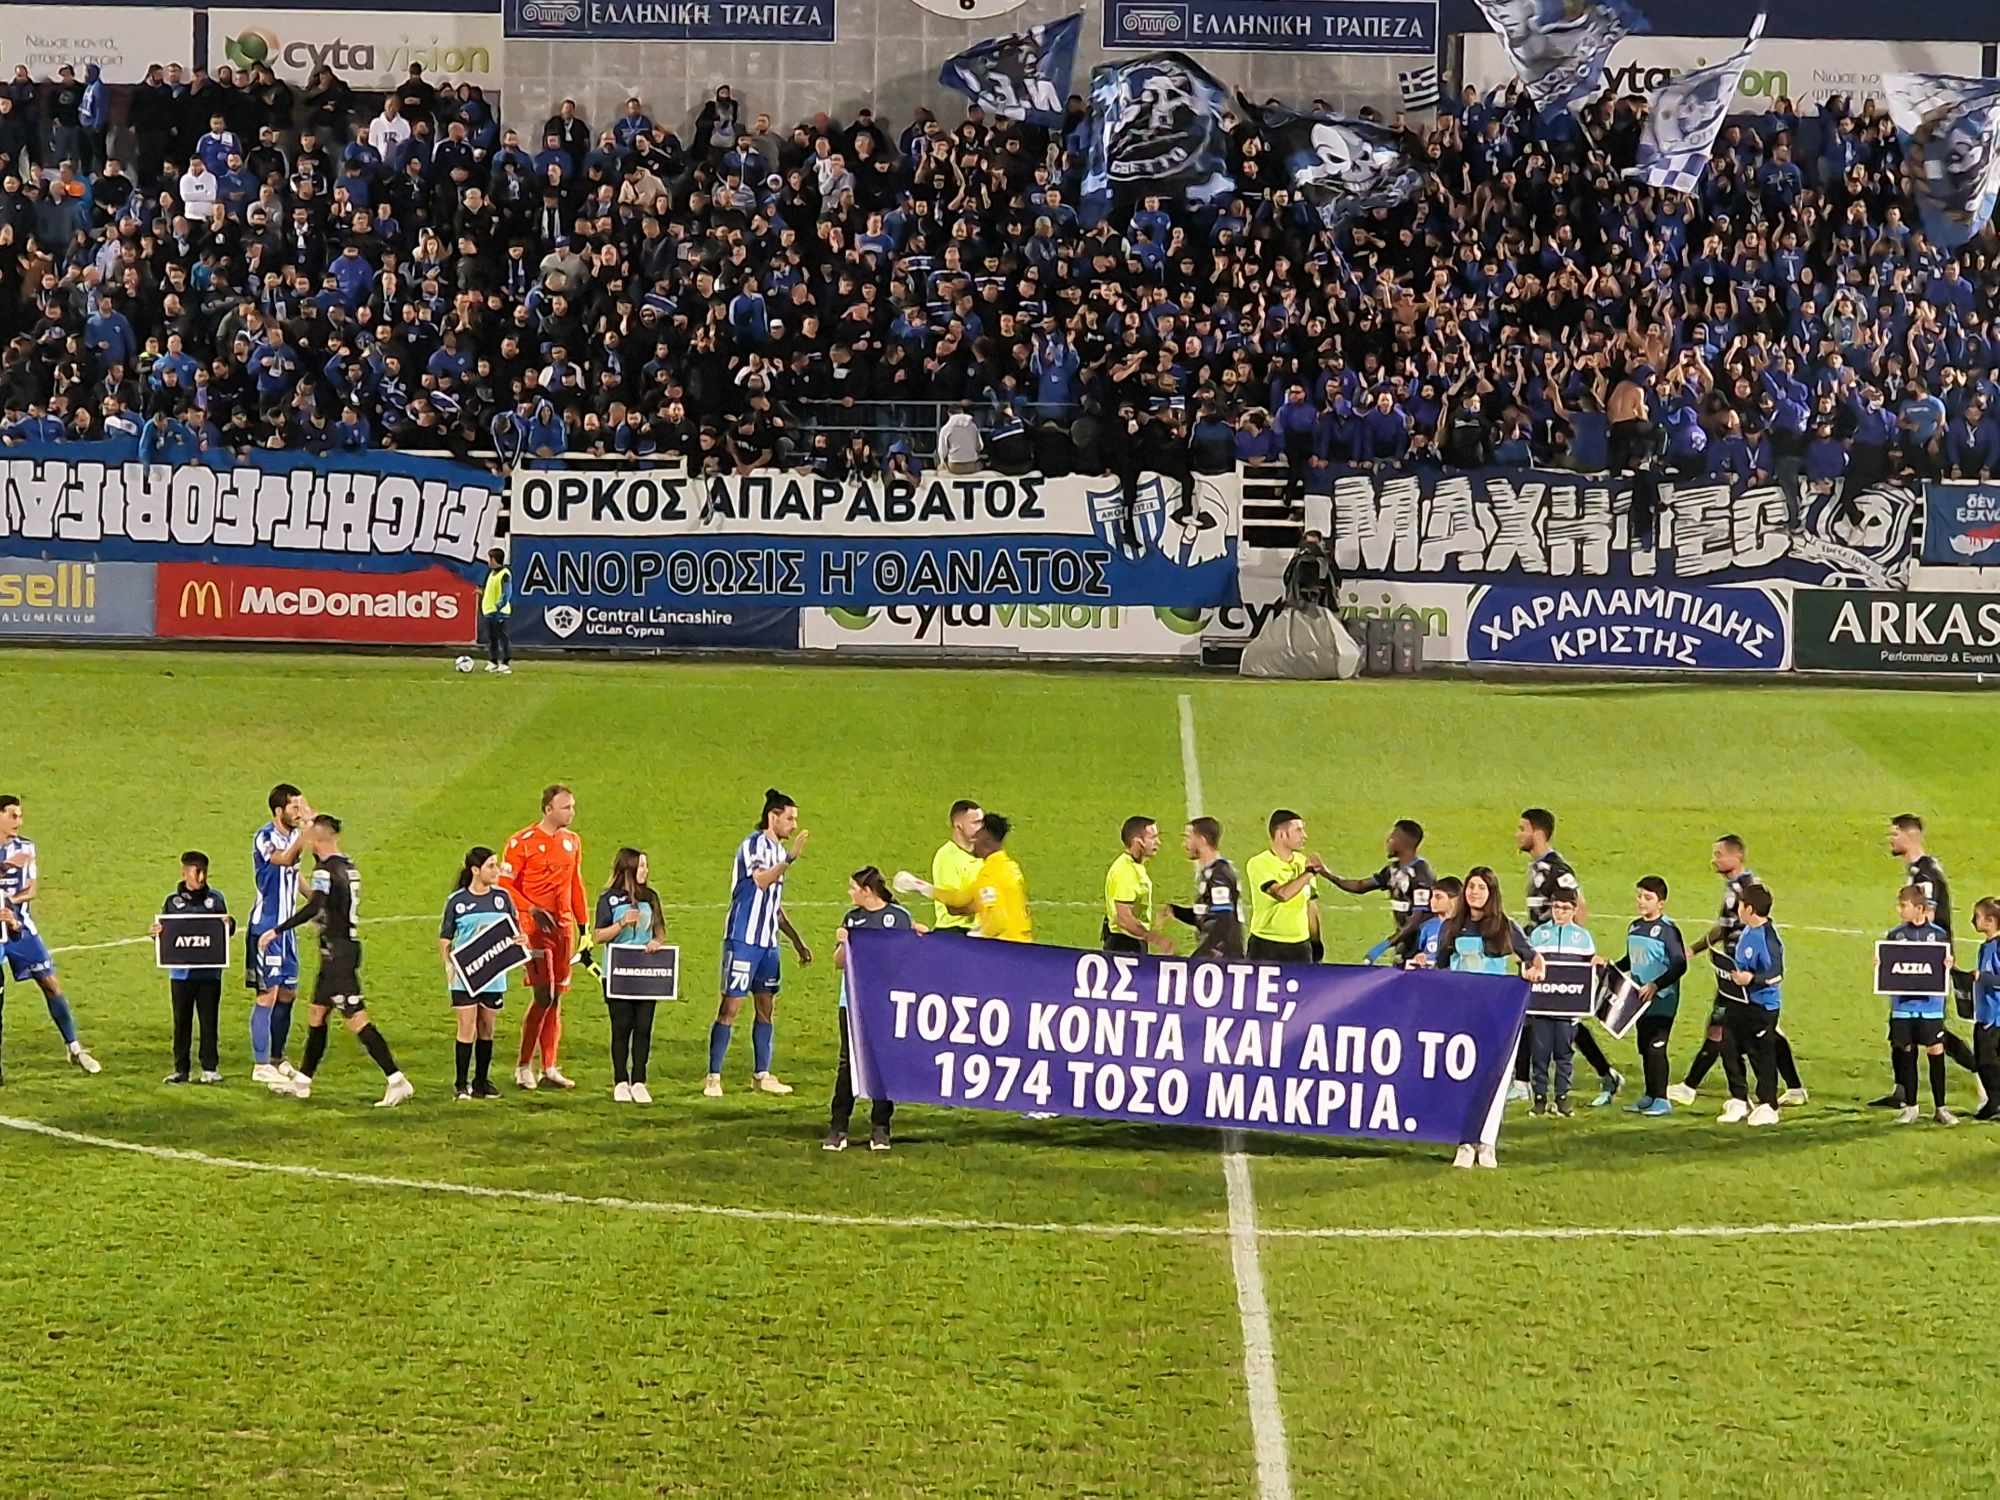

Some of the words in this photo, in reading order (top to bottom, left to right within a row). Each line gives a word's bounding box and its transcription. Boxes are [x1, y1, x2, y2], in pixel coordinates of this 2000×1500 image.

[591, 2, 709, 25] ΕΛΛΗΝΙΚΗ
[720, 5, 823, 26] ΤΡΑΠΕΖΑ
[1193, 13, 1312, 36] ΕΛΛΗΝΙΚΗ
[1323, 16, 1425, 38] ΤΡΑΠΕΖΑ
[0, 460, 104, 540] FA
[123, 464, 261, 544] FOR
[273, 470, 488, 562] FIGHT
[522, 477, 688, 521] ΟΡΚΟΣ
[702, 475, 1047, 522] ΑΠΑΡΑΒΑΤΟΣ
[521, 549, 804, 597] ΑΝΟΡΘΩΣΙΣ
[2, 612, 96, 624] ALUMINIUM
[240, 586, 459, 619] McDonald's
[586, 606, 644, 623] Central
[650, 607, 733, 625] Lancashire
[586, 625, 623, 635] UCLan
[625, 625, 665, 638] Cyprus
[1480, 588, 1775, 658] ΧΑΡΑΛΑΜΠΙΔΗΣ
[1828, 600, 2000, 648] ARKAS
[1550, 626, 1702, 665] ΚΡΙΣΤΗΣ
[1880, 650, 1949, 663] Performance
[1951, 653, 1960, 663] &
[1962, 652, 1994, 664] Event
[175, 935, 211, 948] ΛΥΣΗ
[729, 971, 750, 991] 70
[1891, 962, 1933, 975] ΑΣΣΙΑ
[1074, 953, 1139, 1003] ΩΣ
[1157, 961, 1299, 1022] ΠΟΤΕ;
[1531, 983, 1585, 994] ΜΟΡΦΟΥ
[889, 990, 1011, 1046] ΤΟΣΟ
[1027, 1004, 1185, 1061] ΚΟΝΤΑ
[1203, 1016, 1285, 1068] ΚΑΙ
[1299, 1023, 1402, 1076] ΑΠΟ
[1416, 1030, 1478, 1081] ΤΟ
[934, 1052, 1053, 1105] 1974
[1067, 1061, 1190, 1117] ΤΟΣΟ
[1205, 1071, 1418, 1133] ΜΑΚΡΙΑ.
